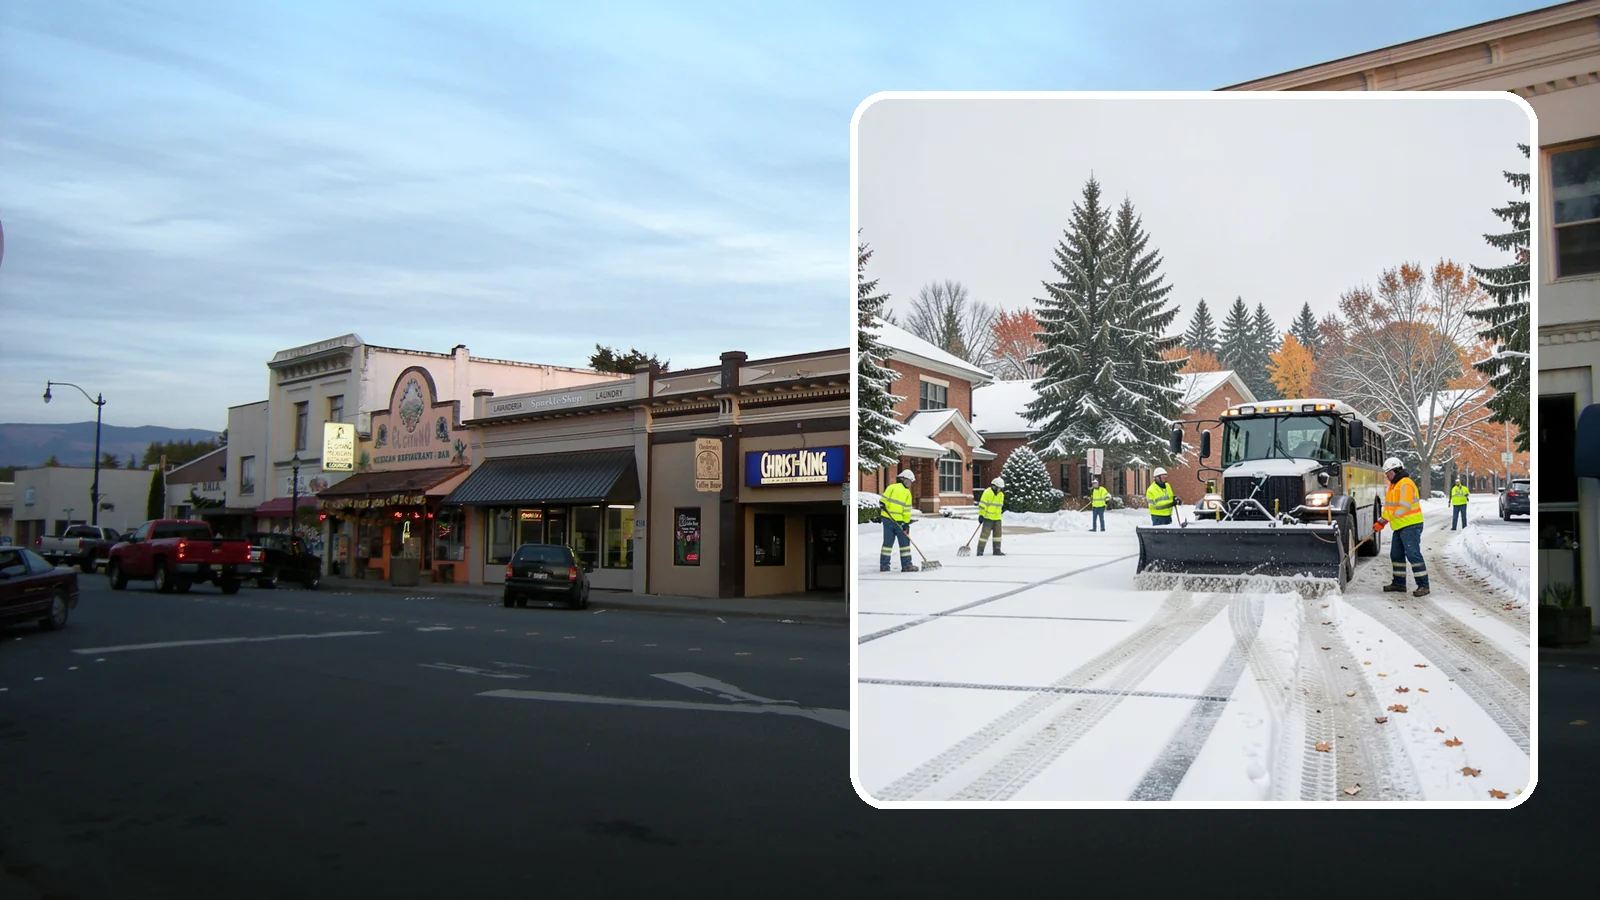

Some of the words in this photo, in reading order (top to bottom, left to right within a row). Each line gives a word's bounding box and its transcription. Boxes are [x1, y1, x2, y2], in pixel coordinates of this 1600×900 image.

[595, 388, 624, 400] LAUNDRY
[493, 401, 523, 413] LAVANDERIA
[530, 396, 562, 409] Sparkle
[562, 394, 583, 405] Shop
[373, 454, 396, 464] MEXICAN
[397, 451, 433, 462] RESTAURANT
[437, 449, 450, 459] BAR
